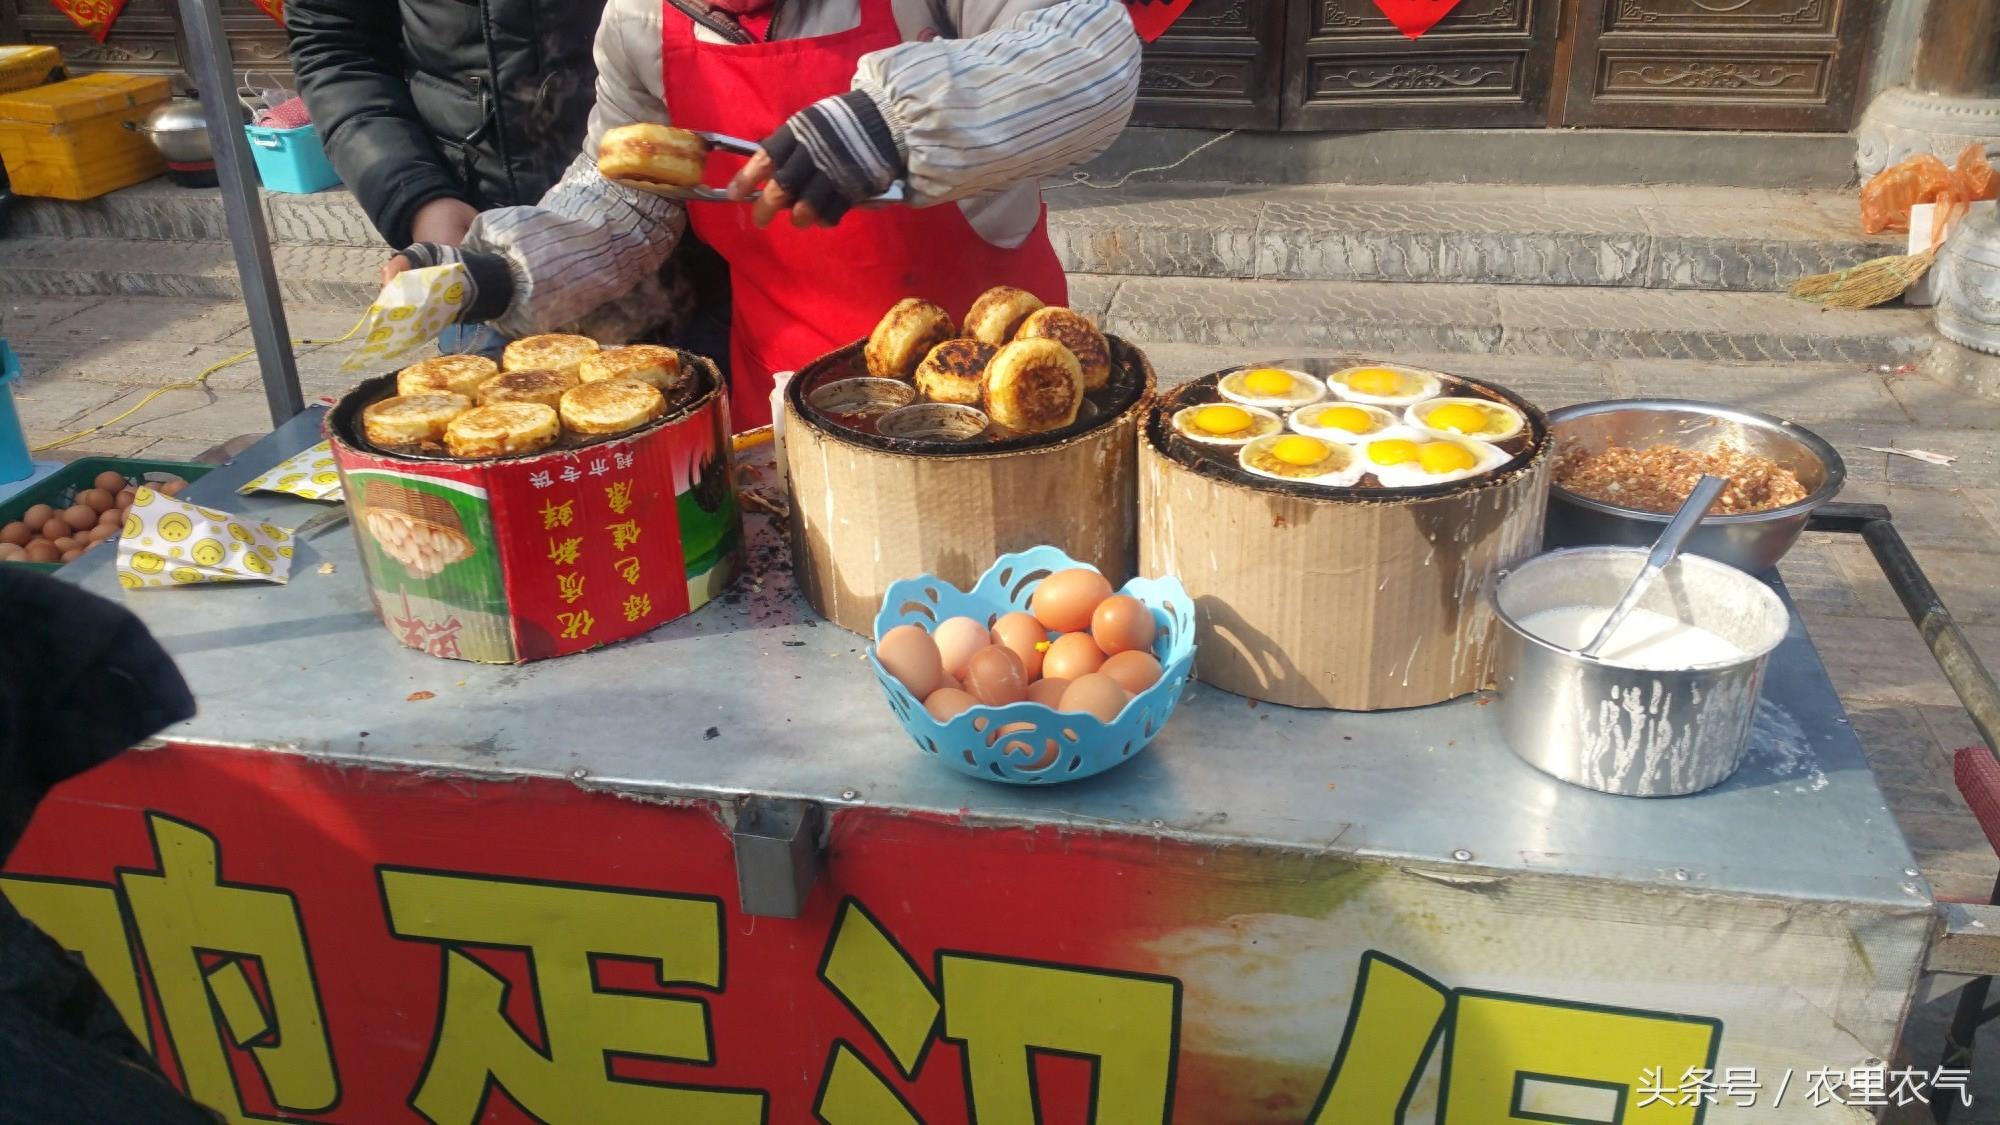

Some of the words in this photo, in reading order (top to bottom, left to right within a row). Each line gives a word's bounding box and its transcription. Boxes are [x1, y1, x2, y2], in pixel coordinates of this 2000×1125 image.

[529, 450, 635, 489] 超市专供
[538, 497, 595, 639] 优质新鲜
[604, 478, 653, 622] 绿色健康
